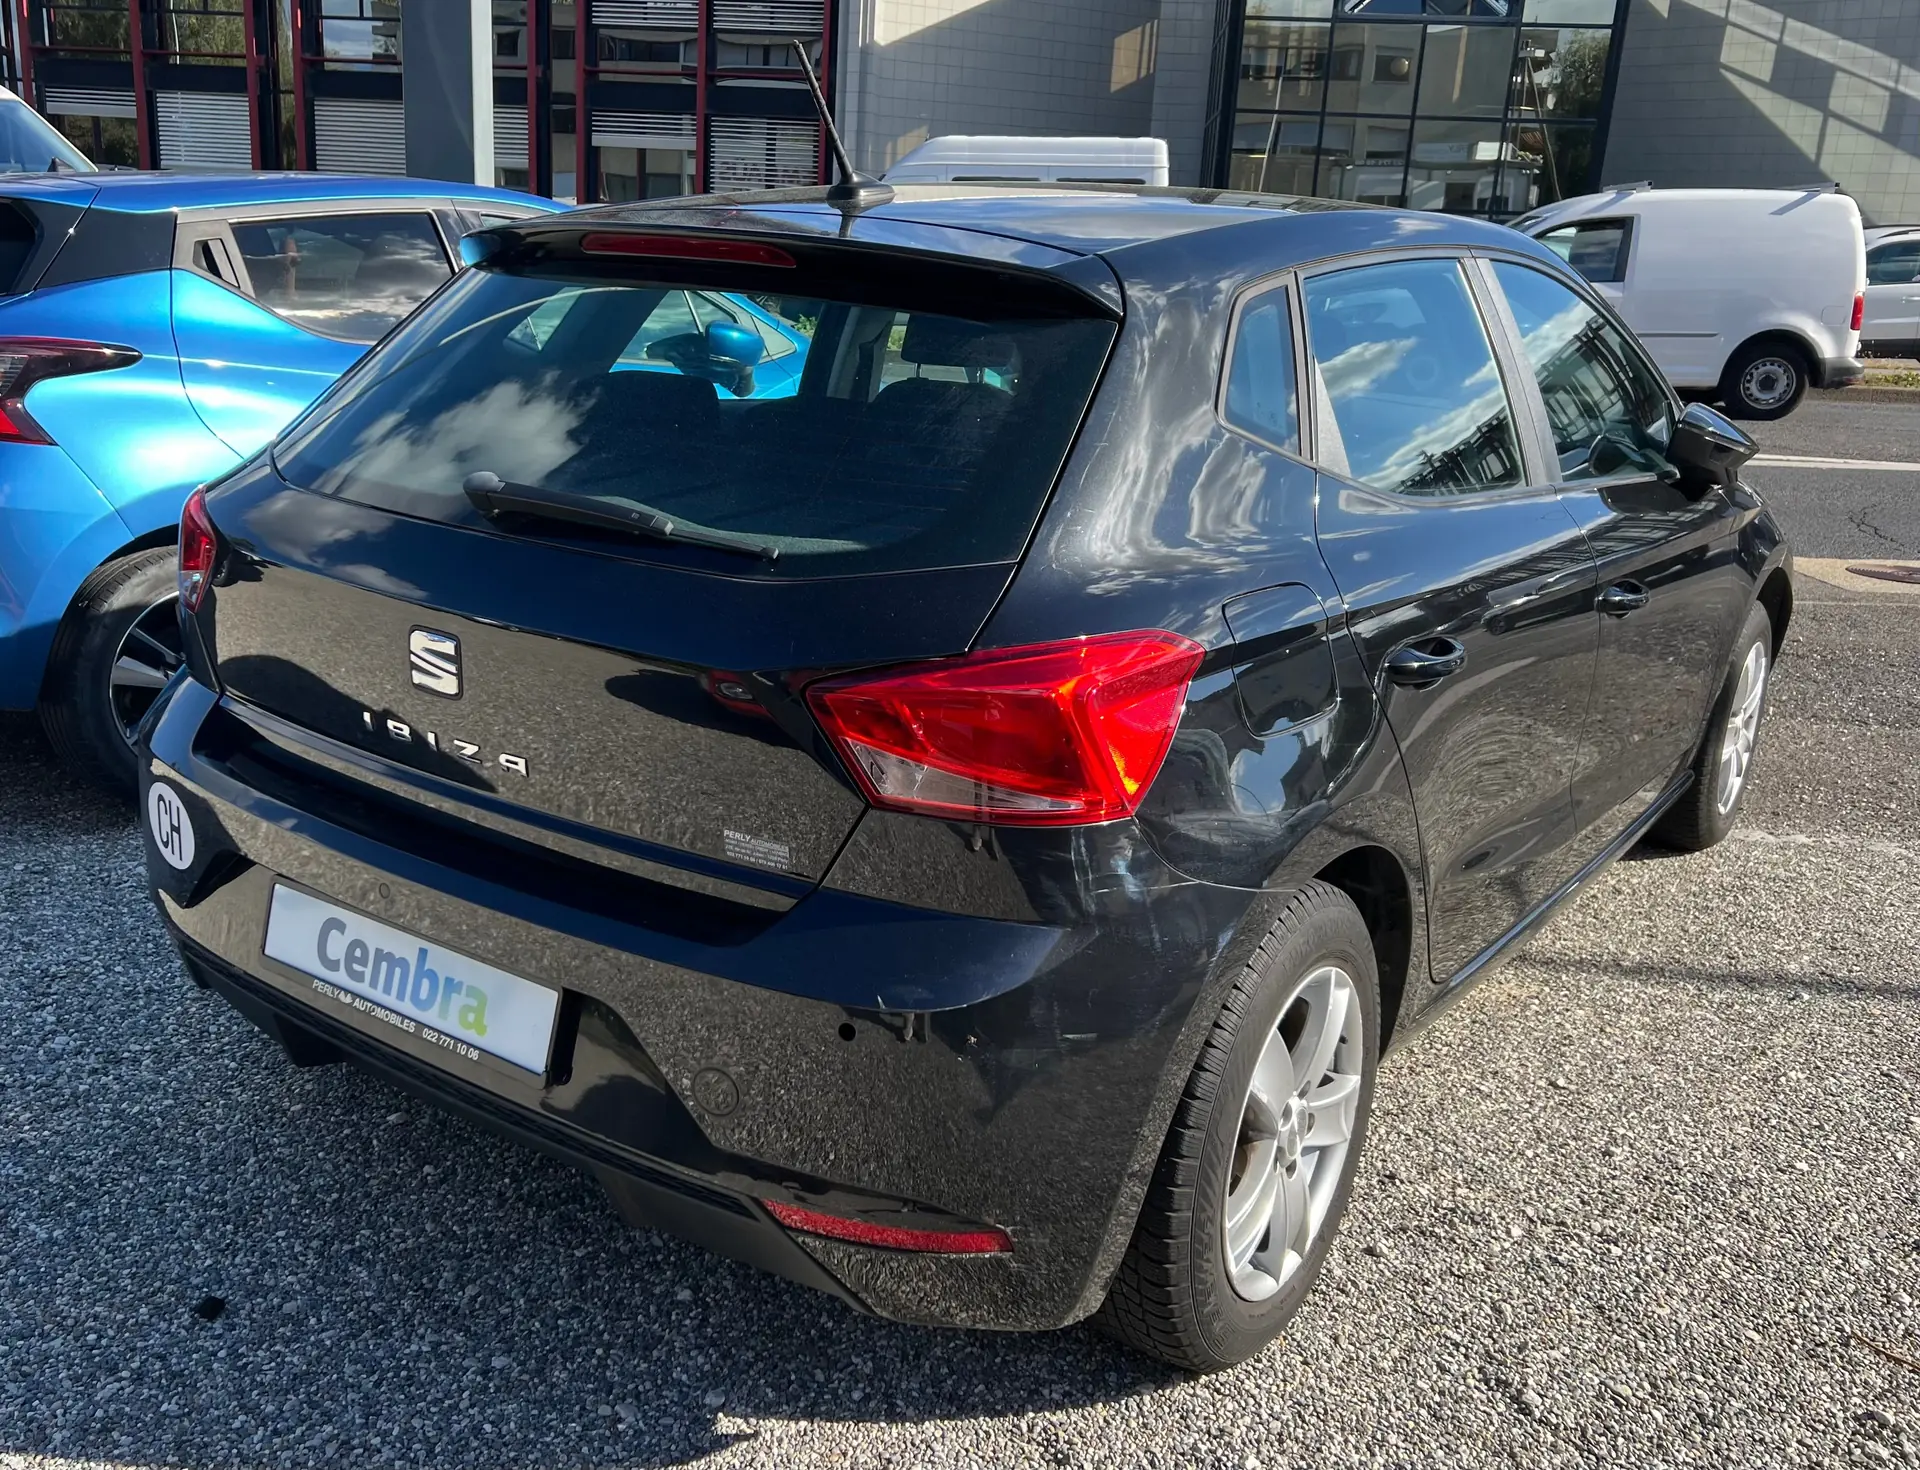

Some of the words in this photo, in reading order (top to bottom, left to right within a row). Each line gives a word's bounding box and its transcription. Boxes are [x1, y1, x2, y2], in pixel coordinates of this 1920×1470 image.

[362, 711, 529, 778] IBIZA
[157, 793, 182, 861] CH
[723, 829, 751, 842] PERLY
[312, 979, 340, 999] PERLY
[352, 997, 416, 1033] AUTOMOBILES
[316, 916, 489, 1038] Cembra
[422, 1027, 439, 1043] 022
[438, 1035, 455, 1050] 771
[456, 1042, 467, 1056] 10
[467, 1047, 480, 1061] 06
